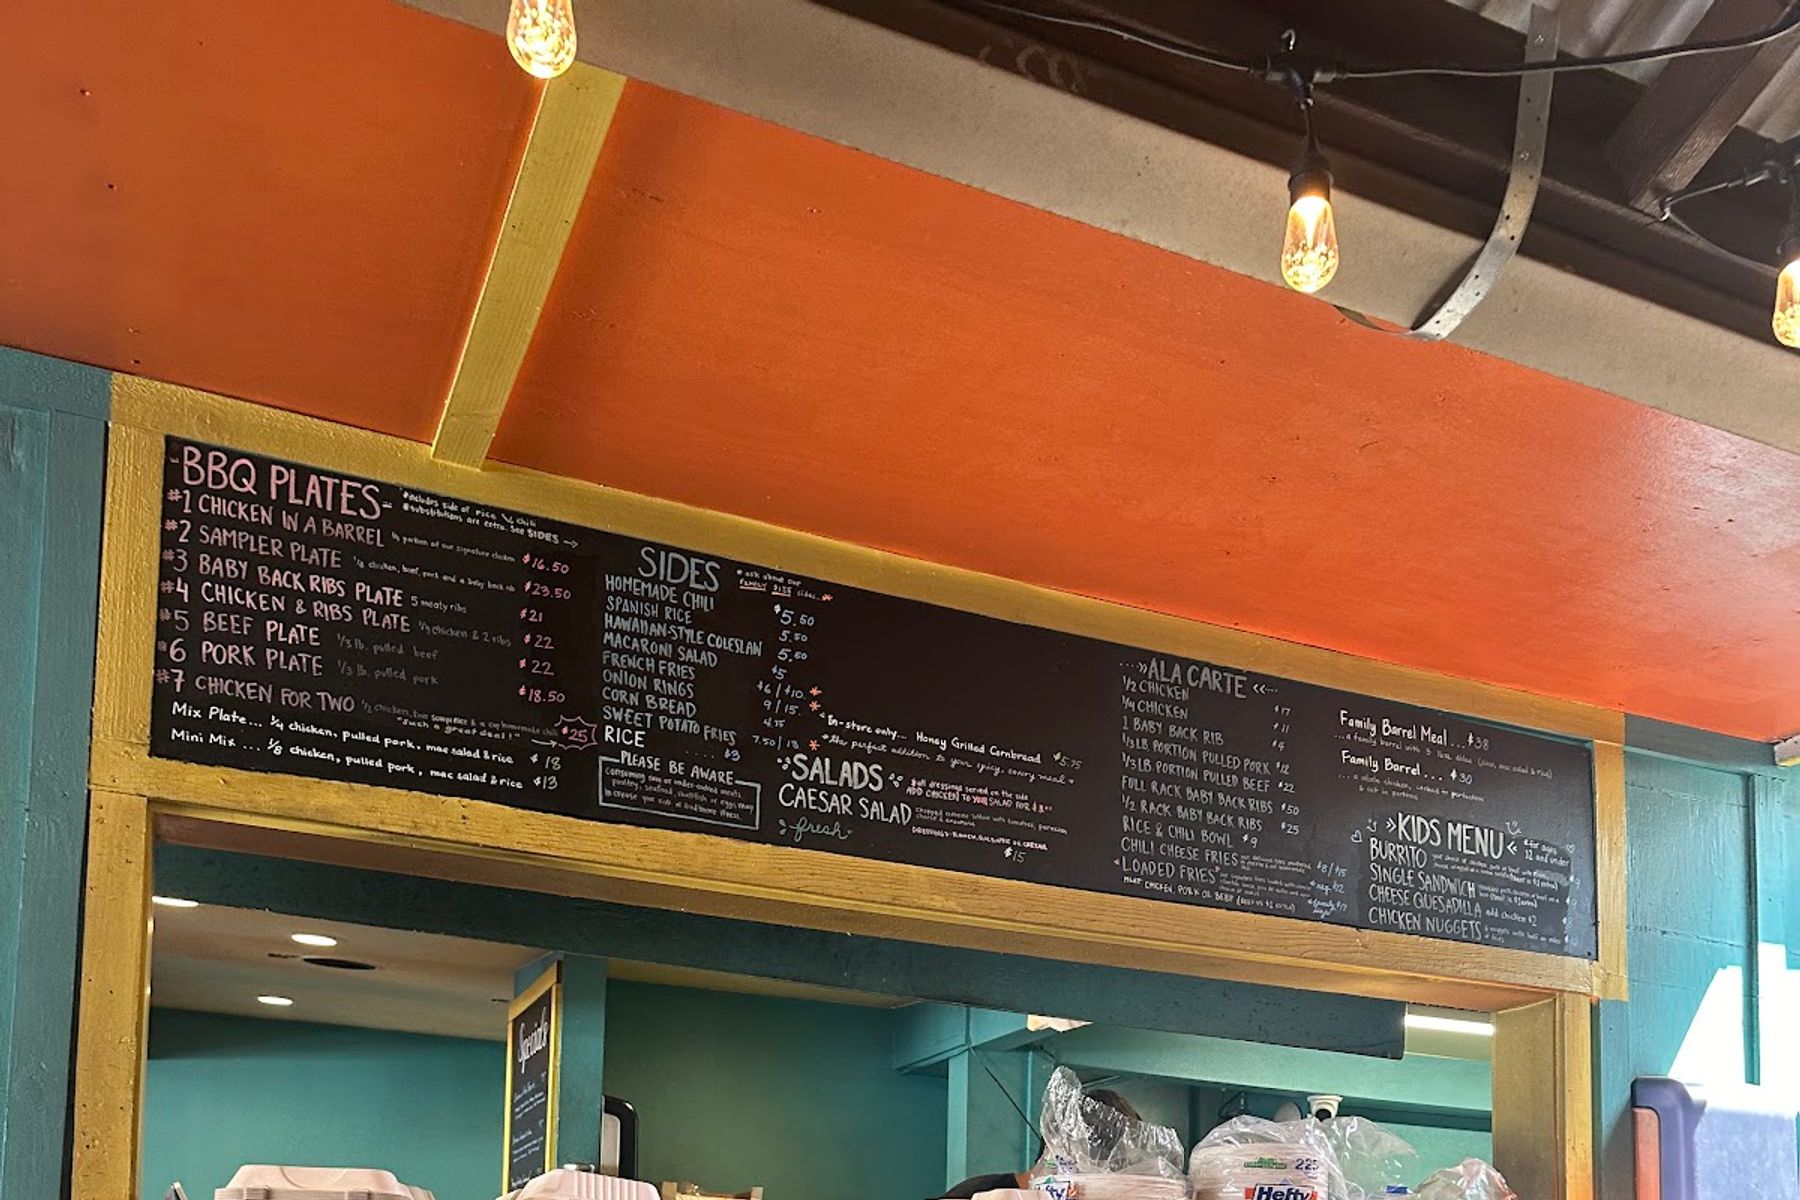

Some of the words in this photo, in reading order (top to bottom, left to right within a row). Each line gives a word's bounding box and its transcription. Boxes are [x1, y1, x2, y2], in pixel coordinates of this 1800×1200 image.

[183, 446, 257, 495] BBQ
[270, 464, 382, 520] PLATES
[167, 489, 191, 513] #1
[199, 493, 273, 525] CHICKEN
[282, 510, 298, 531] IN
[304, 516, 316, 535] A
[322, 518, 385, 547] BARREL
[522, 553, 570, 574] $16.50
[165, 519, 192, 543] #2
[199, 525, 283, 557] SAMPLER
[290, 541, 342, 568] PLATE
[524, 581, 572, 600] $23.50
[637, 546, 721, 593] SIDES
[163, 549, 189, 572] #3
[199, 554, 248, 579] BABY
[258, 565, 305, 593] BACK
[309, 574, 346, 597] RIBS
[355, 582, 404, 607] PLATE
[519, 609, 544, 623] $21
[605, 574, 679, 604] HOMEMADE
[683, 591, 715, 613] CHILI
[160, 577, 189, 602] #4
[200, 581, 285, 612] CHICKEN
[296, 599, 307, 615] &
[313, 601, 354, 622] RIBS
[362, 607, 411, 632] PLATE
[524, 633, 555, 650] $22
[606, 595, 659, 619] SPANISH
[664, 605, 692, 625] RICE
[202, 610, 254, 636] BEEF
[265, 620, 321, 646] PLATE
[519, 658, 555, 676] $22
[603, 631, 674, 659] MACARONI
[678, 645, 718, 669] SALAD
[201, 640, 256, 667] PORK
[265, 647, 323, 677] PLATE
[519, 684, 566, 704] $18.50
[602, 650, 656, 673] FRENCH
[658, 660, 696, 682] FRIES
[602, 669, 648, 691] ONION
[653, 678, 695, 699] RINGS
[1148, 657, 1182, 686] ALA
[1186, 664, 1248, 699] CARTE
[194, 675, 273, 703] CHICKEN
[280, 688, 312, 709] FOR
[316, 692, 356, 713] TWO
[561, 727, 588, 743] $25
[602, 687, 639, 706] CORN
[645, 694, 698, 718] BREAD
[1139, 679, 1190, 702] CHICKEN
[603, 705, 654, 729] SWEET
[659, 715, 701, 735] POTATO
[703, 725, 737, 746] FRIES
[1137, 699, 1189, 720] CHICKEN
[1339, 709, 1377, 737] Family
[1381, 718, 1418, 741] Barrel
[171, 701, 202, 718] Mix
[288, 721, 338, 738] chicken,
[342, 730, 380, 745] pulled
[426, 745, 449, 756] mac
[451, 747, 481, 760] salad
[491, 752, 514, 764] rice
[604, 725, 647, 748] RICE
[1133, 717, 1162, 735] BABY
[1169, 724, 1198, 742] BACK
[1203, 730, 1224, 746] RIB
[171, 728, 204, 744] Mini
[209, 733, 237, 748] Mix
[345, 755, 384, 769] pulled
[457, 769, 487, 783] salad
[500, 777, 523, 790] rice
[533, 776, 559, 791] $13
[620, 750, 661, 772] PLEASE
[668, 760, 685, 776] BE
[691, 766, 734, 785] AWARE
[791, 753, 884, 791] SALADS
[1153, 739, 1198, 763] PORTION
[1202, 750, 1240, 771] PULLED
[1243, 759, 1271, 776] PORK
[1341, 750, 1379, 773] Family
[1384, 759, 1421, 777] Barrel
[1121, 775, 1147, 793] FULL
[1151, 780, 1182, 800] RACK
[1186, 787, 1214, 805] BABY
[1218, 792, 1247, 810] BACK
[1248, 798, 1274, 815] RIBS
[1156, 761, 1199, 782] PORTION
[1203, 769, 1239, 789] PULLED
[1242, 775, 1271, 793] BEEF
[778, 783, 854, 817] CAESAR
[859, 798, 912, 826] SALAD
[1140, 798, 1173, 817] RACK
[1176, 805, 1204, 821] BABY
[1206, 810, 1235, 828] BACK
[1238, 817, 1263, 832] RIBS
[1122, 817, 1151, 836] RICE
[1168, 824, 1195, 842] CHILI
[1200, 828, 1234, 849] BOWL
[1398, 812, 1442, 847] KIDS
[1447, 822, 1505, 860] MENU
[1120, 837, 1155, 857] CHILI
[1160, 841, 1199, 863] CHEESE
[1205, 848, 1240, 868] FRIES
[1121, 856, 1176, 879] LOADED
[1180, 863, 1217, 885] FRIES
[1369, 837, 1428, 869] BURRITO
[1370, 862, 1415, 888] SINGLE
[1418, 871, 1476, 899] SANDWICH
[1369, 883, 1412, 907] CHEESE
[1413, 891, 1483, 919] QUESADILLA
[1369, 906, 1422, 932] CHICKEN
[1426, 916, 1483, 940] NUGGETS
